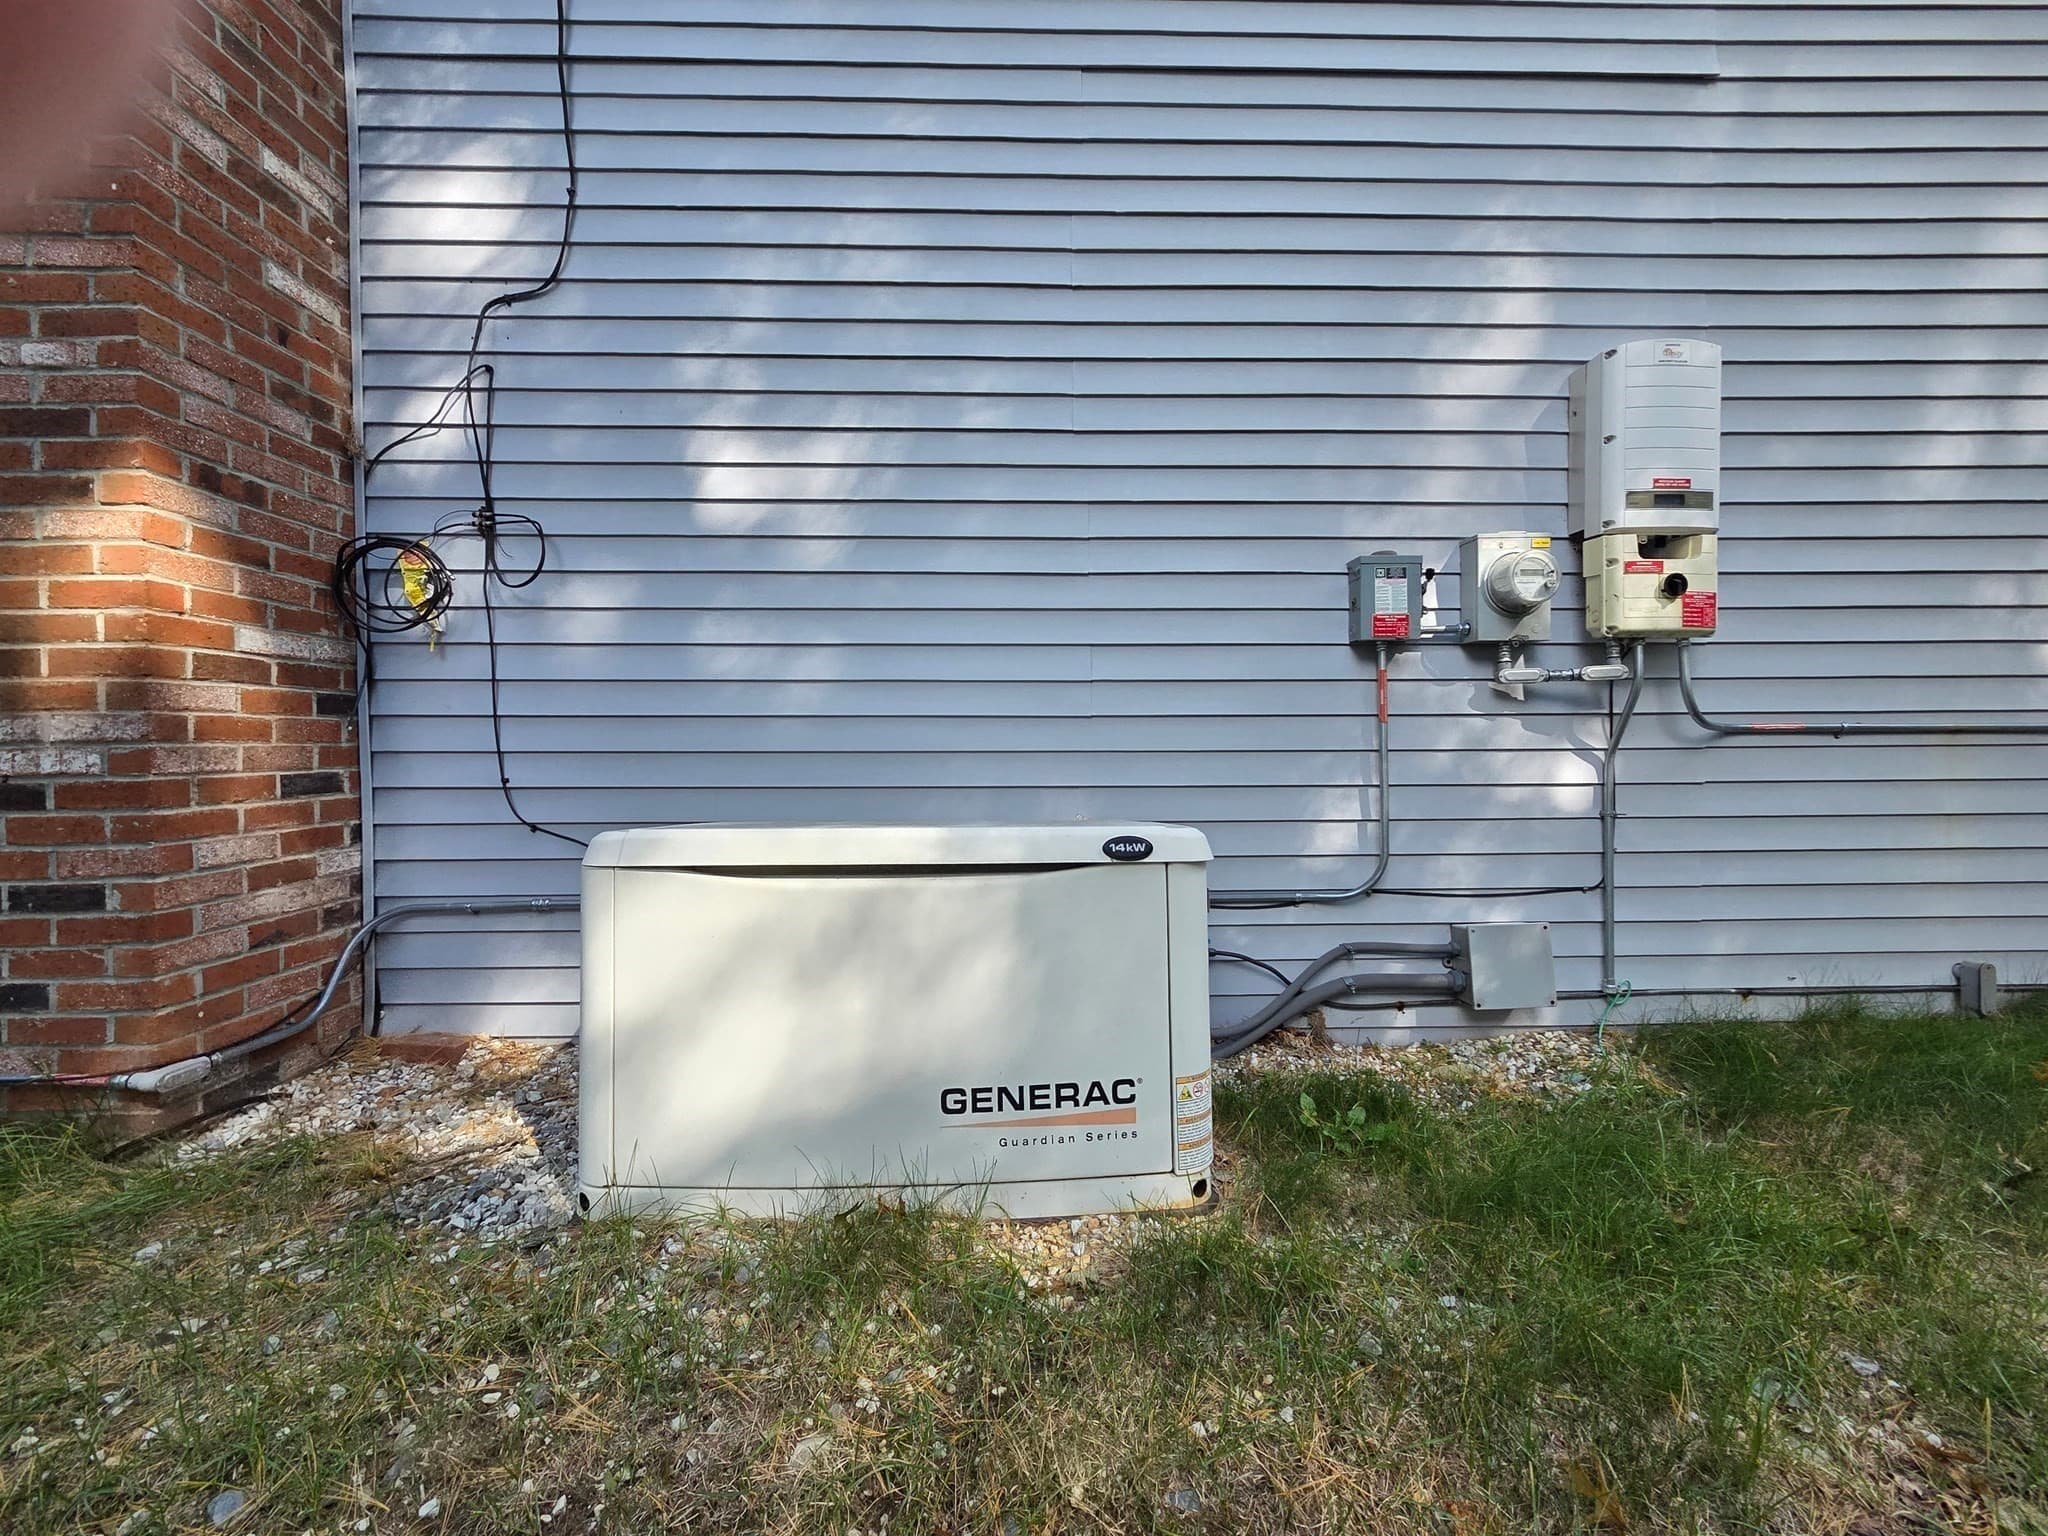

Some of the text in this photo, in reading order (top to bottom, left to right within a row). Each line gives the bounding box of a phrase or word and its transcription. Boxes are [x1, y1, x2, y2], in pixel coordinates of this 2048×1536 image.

[1109, 843, 1146, 852] 14kW
[940, 1078, 1137, 1115] GENERAC
[999, 1130, 1138, 1148] Guardian Series
